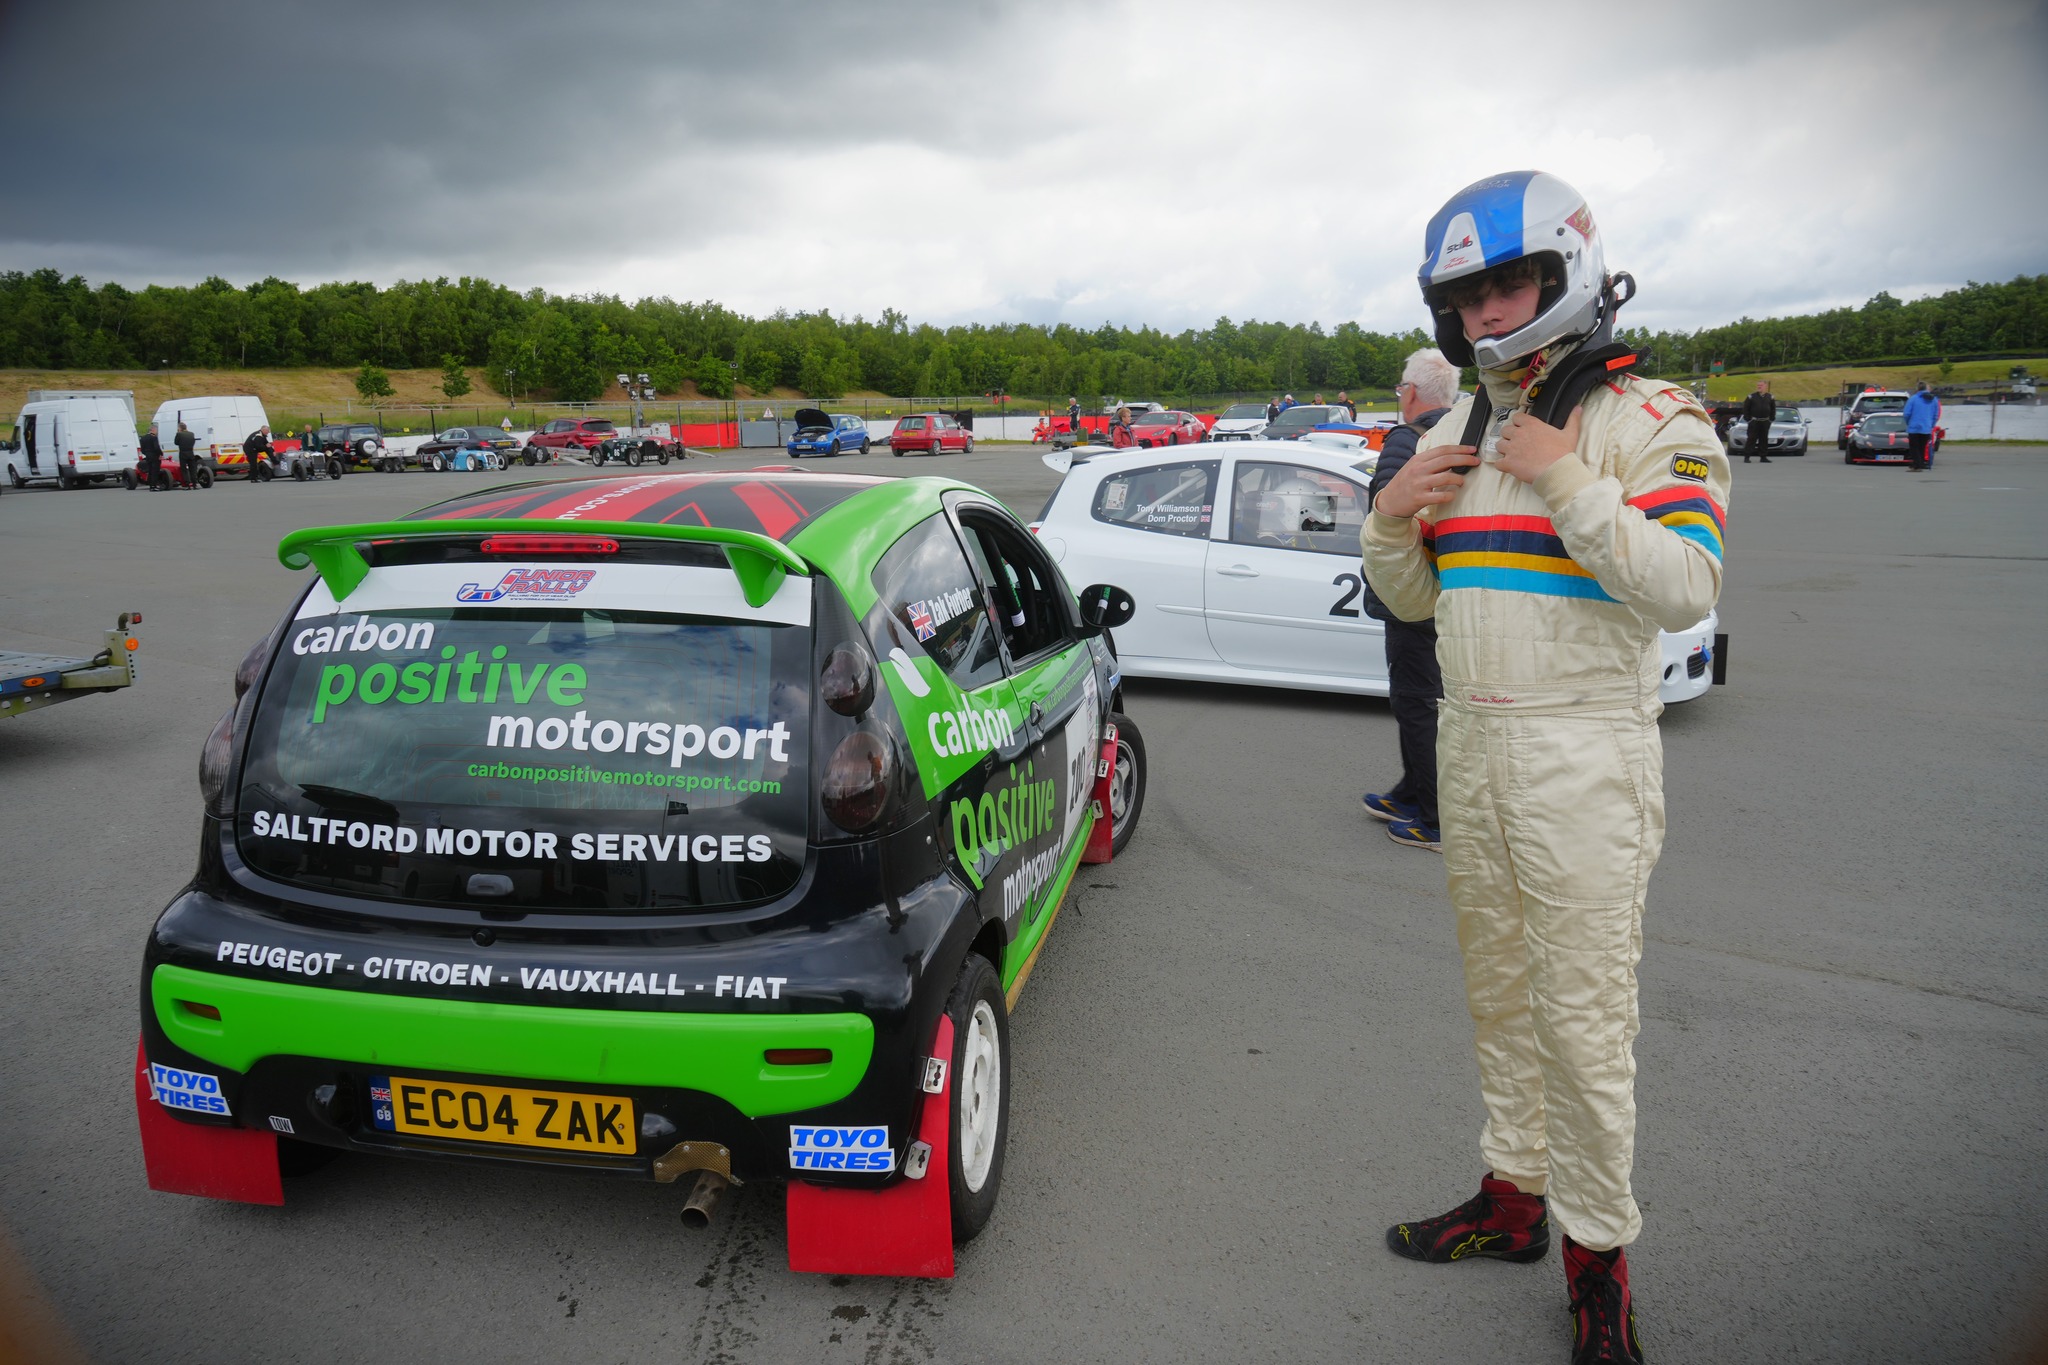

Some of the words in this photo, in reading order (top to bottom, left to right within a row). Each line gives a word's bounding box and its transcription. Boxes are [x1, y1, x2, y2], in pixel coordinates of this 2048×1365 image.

[1675, 460, 1708, 477] OMP
[1137, 504, 1155, 513] Tony
[1157, 504, 1200, 512] Williamson
[1148, 514, 1166, 522] Dom
[1167, 514, 1197, 522] Proctor
[508, 581, 588, 594] RALLY
[927, 596, 951, 627] Zak
[943, 587, 975, 618] Furber
[293, 615, 434, 656] carbon
[309, 645, 588, 723] positive
[486, 710, 791, 768] motorsport
[928, 694, 1015, 758] carbon
[467, 760, 782, 795] carbonpositivemotorsport.com
[253, 810, 418, 854] SALTFORD
[425, 828, 558, 859] MOTOR
[570, 832, 773, 863] SERVICES
[950, 760, 1055, 891] positive
[1003, 834, 1063, 922] motorsport
[216, 941, 342, 975] PEUGEOT
[362, 957, 493, 987] CITROEN
[520, 967, 686, 996] VAUXHALL
[715, 975, 787, 999] FIAT
[154, 1066, 219, 1095] TOYO
[155, 1088, 227, 1114] TIRES
[376, 1107, 393, 1121] GB
[533, 1097, 625, 1146] ZAK
[792, 1128, 886, 1149] TOYO
[791, 1150, 892, 1170] TIRES
